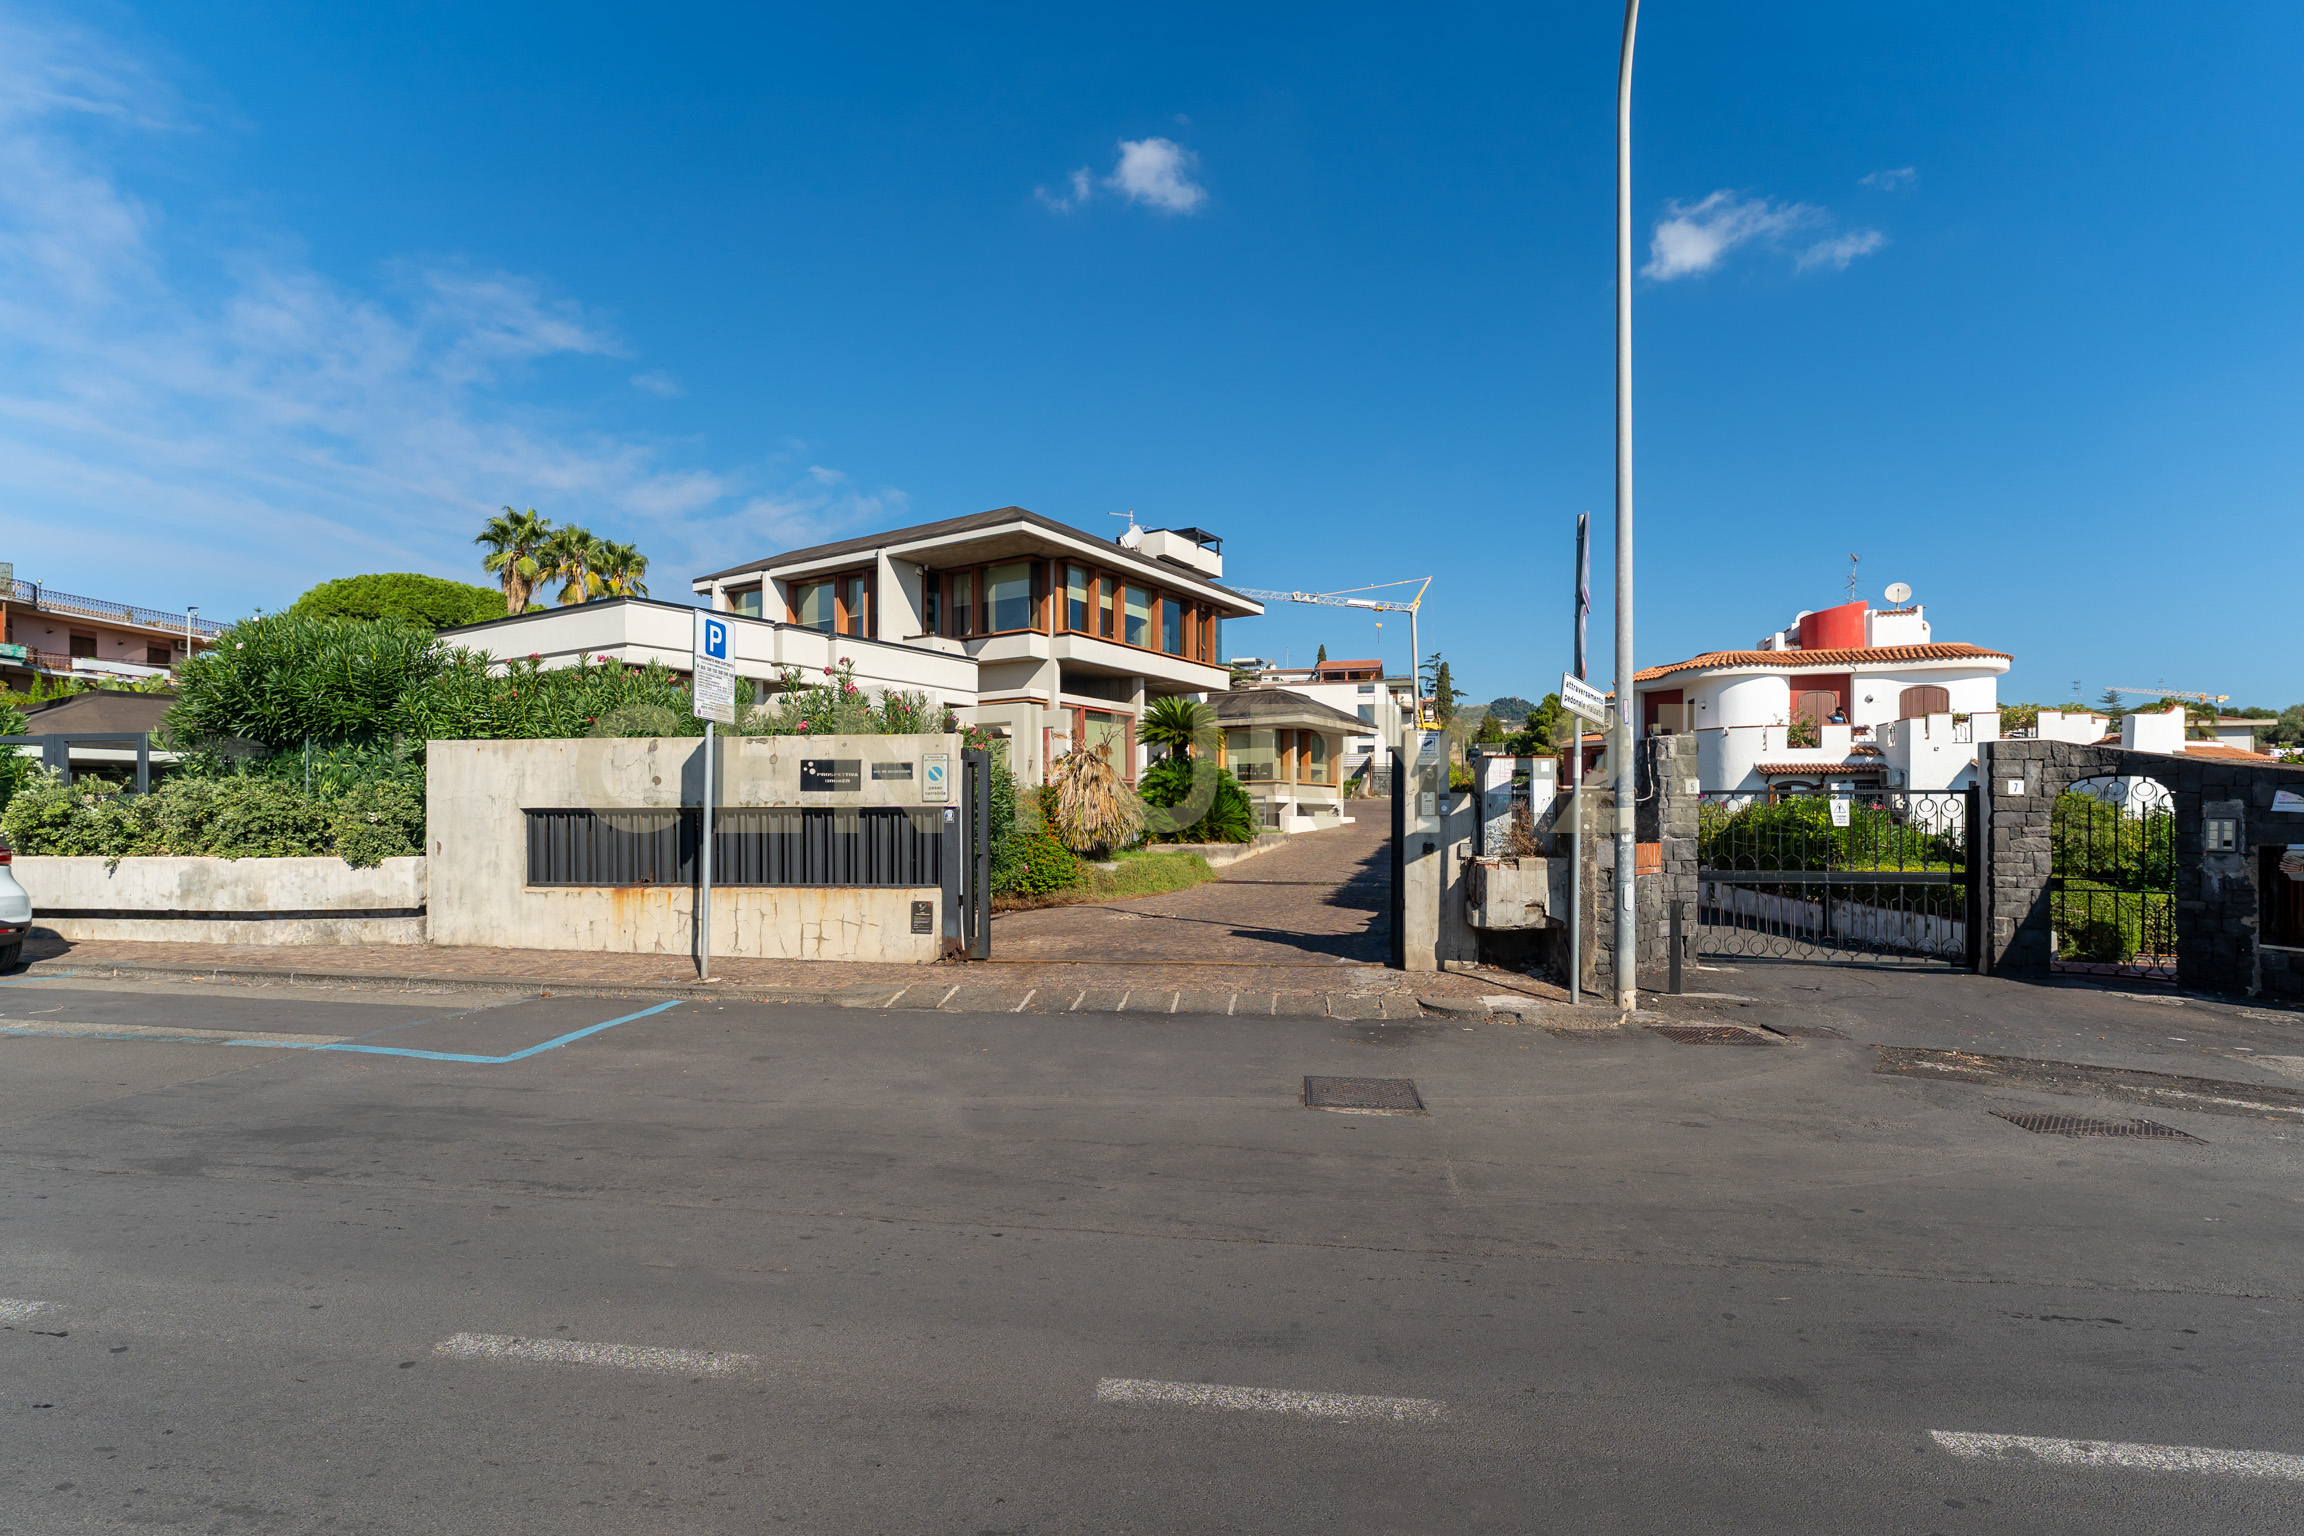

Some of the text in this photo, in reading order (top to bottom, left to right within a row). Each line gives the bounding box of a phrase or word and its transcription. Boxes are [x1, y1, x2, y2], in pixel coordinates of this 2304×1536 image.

[709, 624, 722, 652] P
[1565, 681, 1604, 705] attraversamento
[1564, 694, 1603, 718] pedonale rialzato
